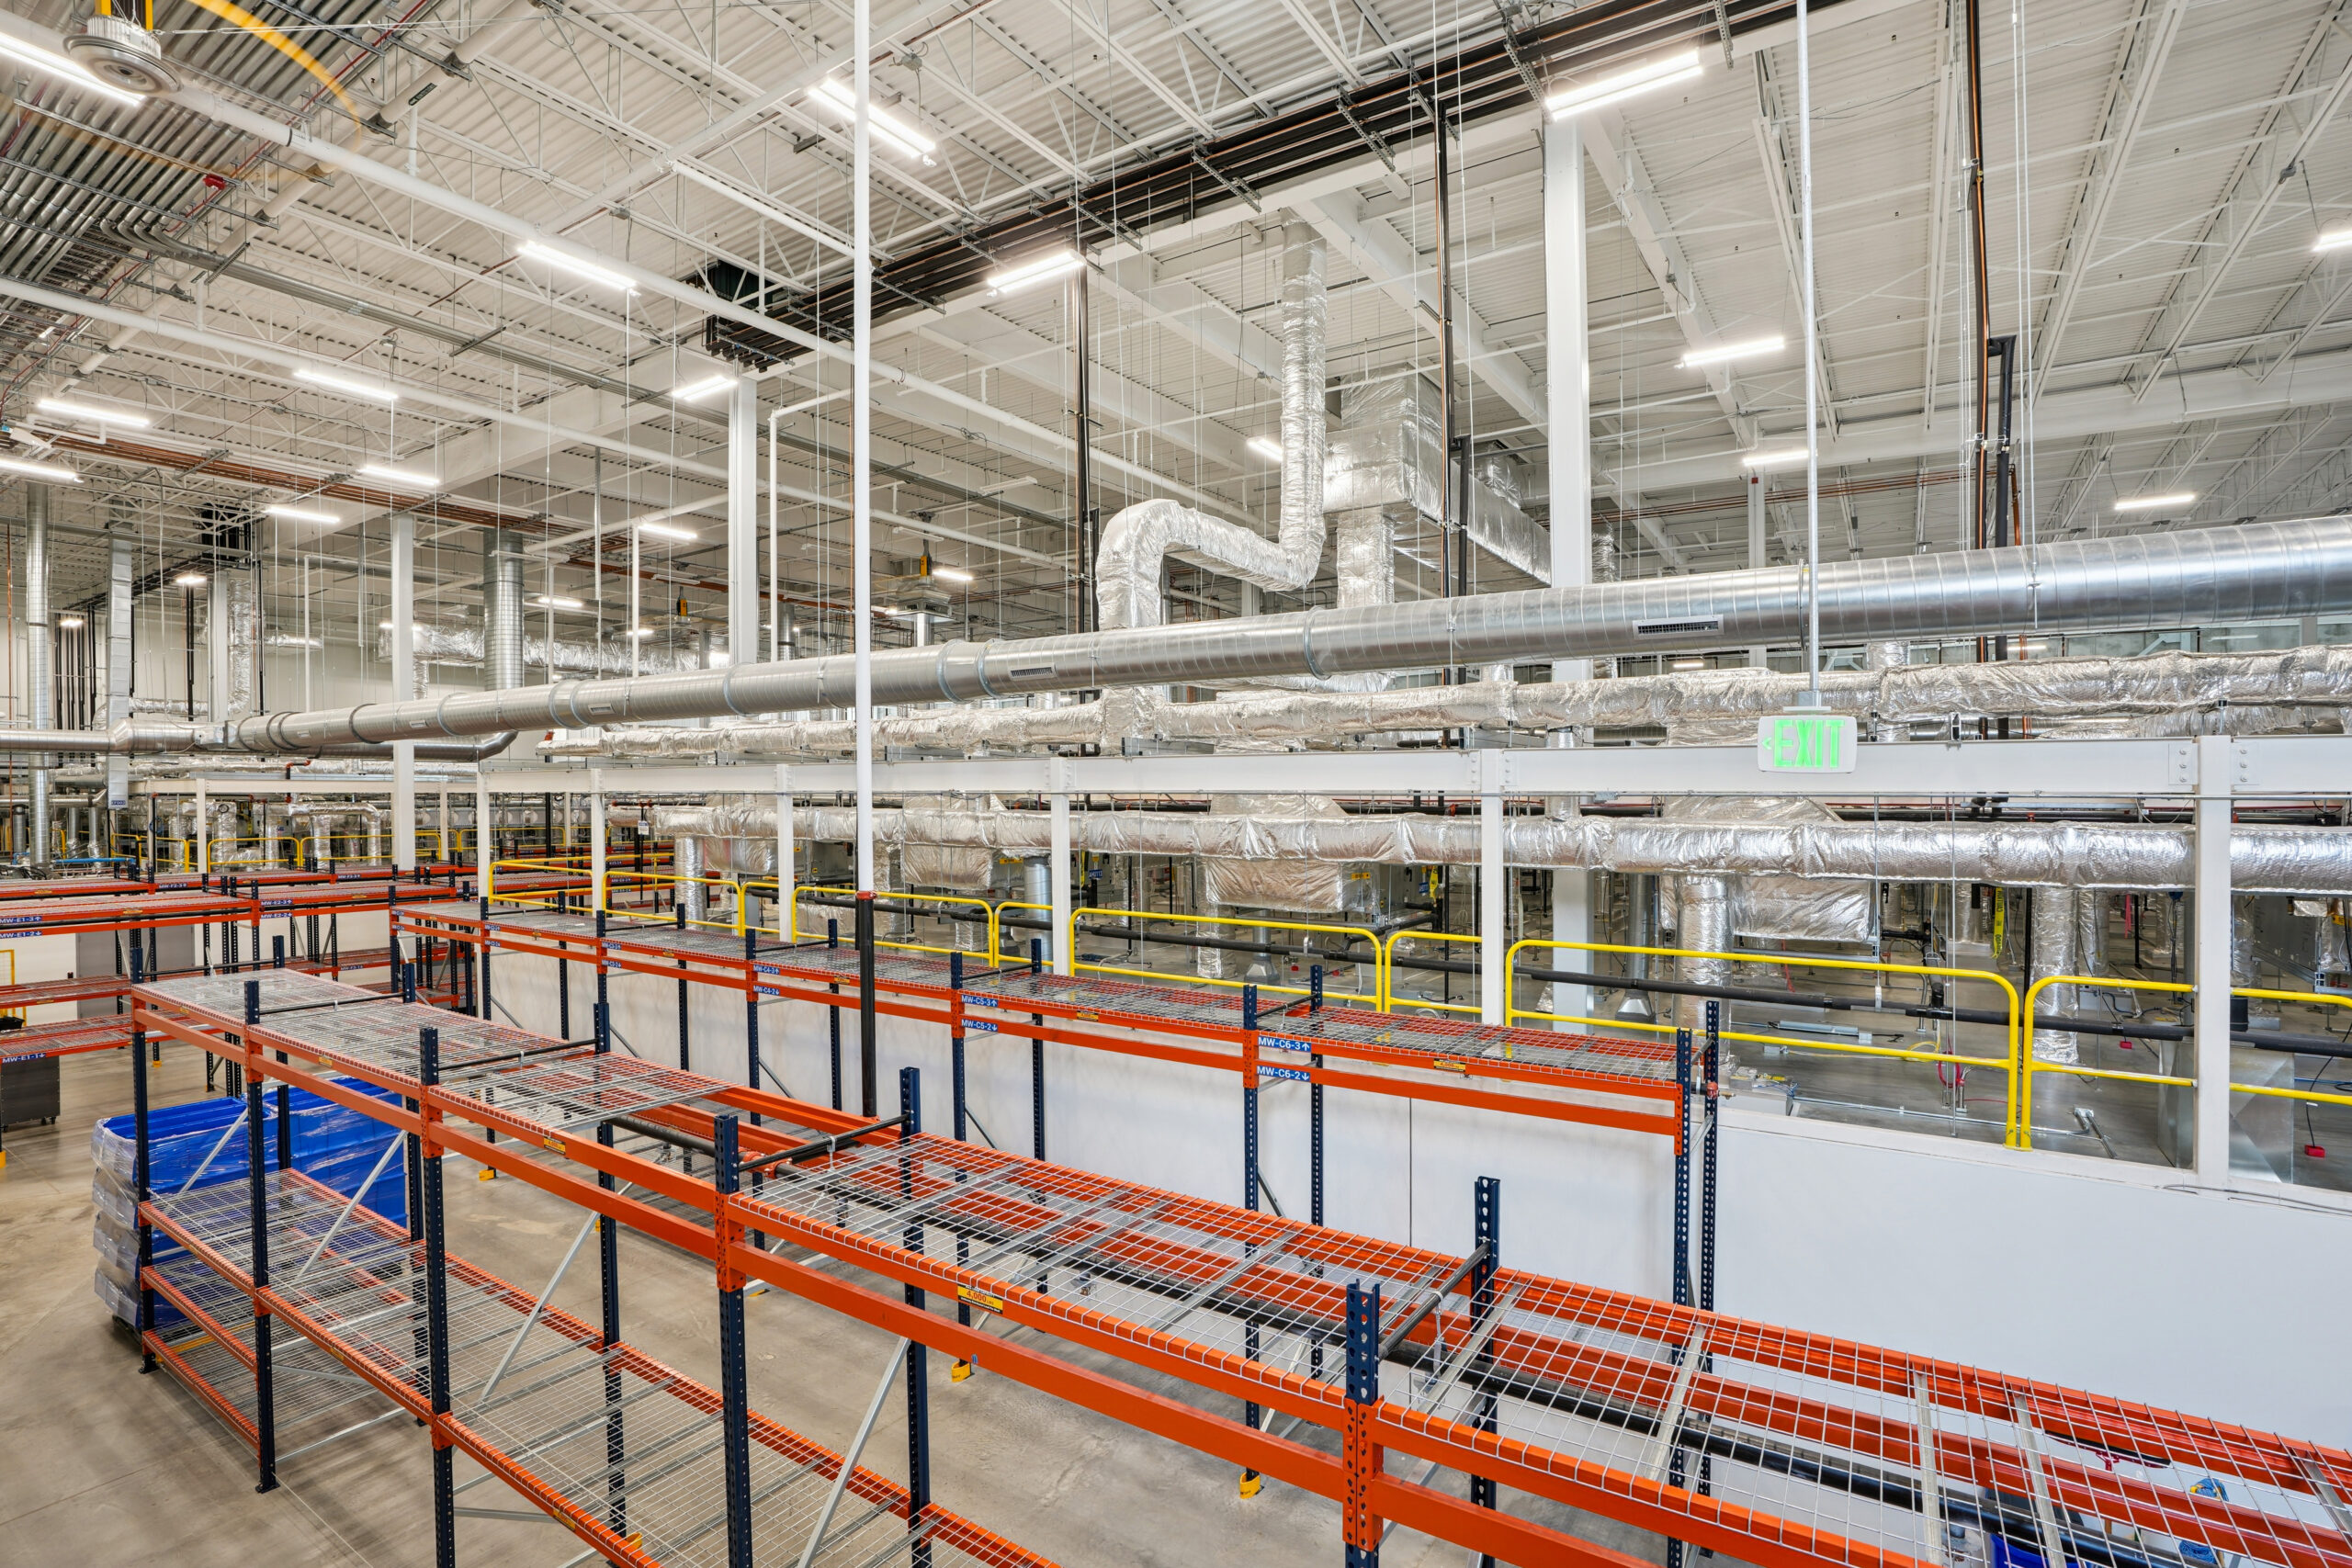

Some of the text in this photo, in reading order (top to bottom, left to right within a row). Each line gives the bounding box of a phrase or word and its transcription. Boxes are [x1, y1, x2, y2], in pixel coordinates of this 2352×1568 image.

[1773, 719, 1845, 768] EXIT
[753, 964, 775, 974] MW-C4-3
[753, 985, 775, 995] MW-C4-2
[961, 995, 991, 1007] MW-C5-3
[961, 1019, 991, 1031] MW-C5-2
[1258, 1036, 1300, 1051] MW-C6-3
[2, 1054, 39, 1064] MW-E1-1
[1256, 1066, 1300, 1081] MW-C6-2
[967, 1290, 987, 1303] 4,000
